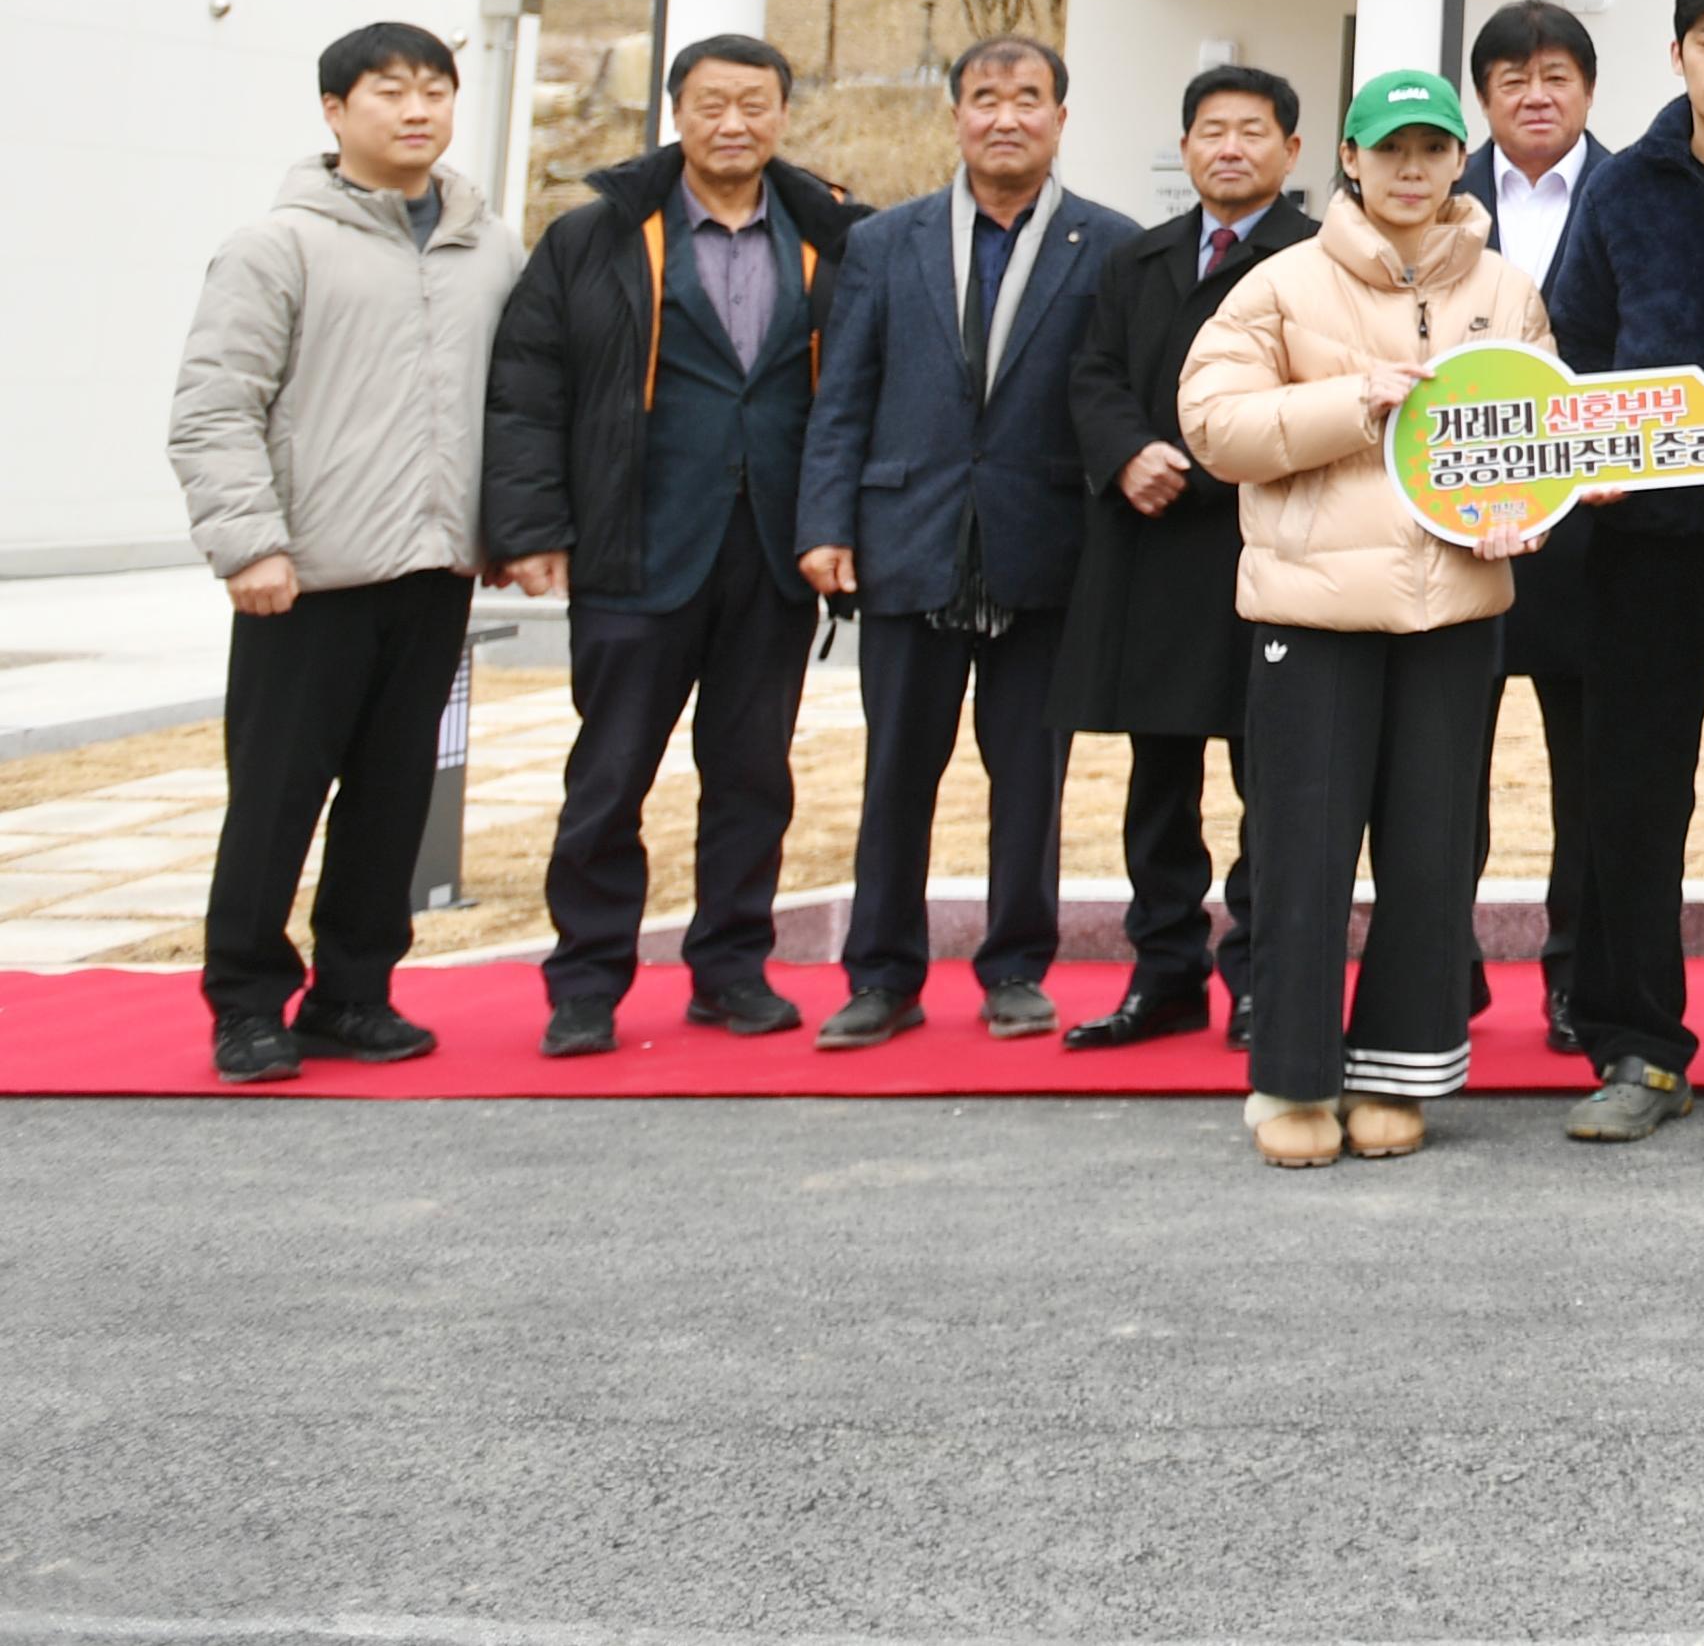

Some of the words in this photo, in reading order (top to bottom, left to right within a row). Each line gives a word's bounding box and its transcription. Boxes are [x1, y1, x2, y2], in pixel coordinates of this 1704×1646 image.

[1430, 403, 1532, 442] 거례리
[1545, 389, 1684, 433] 신혼부부
[1430, 435, 1641, 487] 공공임대주택
